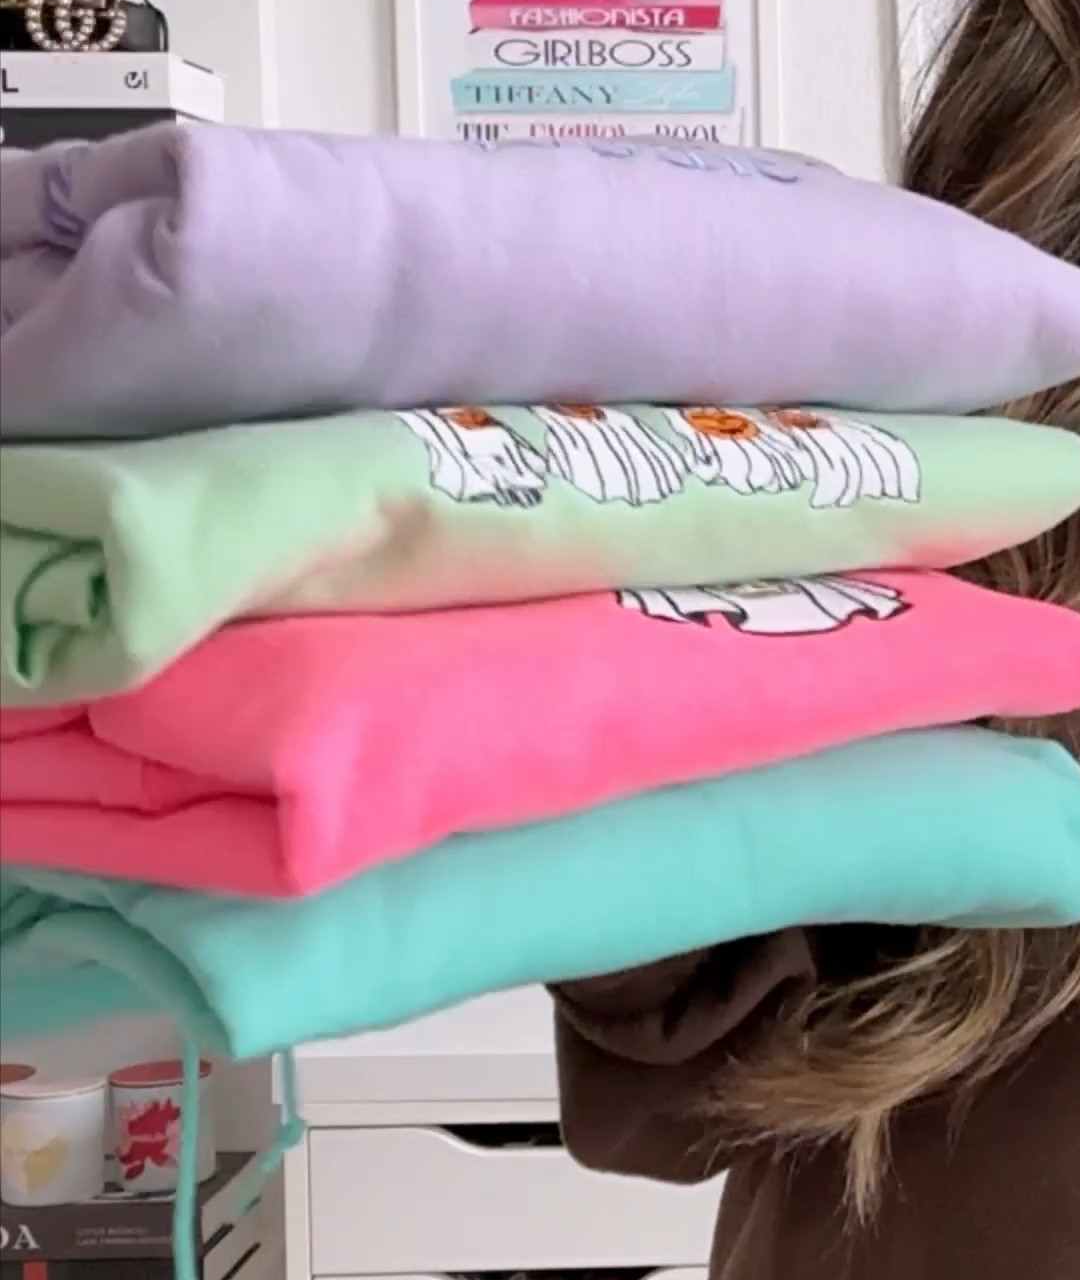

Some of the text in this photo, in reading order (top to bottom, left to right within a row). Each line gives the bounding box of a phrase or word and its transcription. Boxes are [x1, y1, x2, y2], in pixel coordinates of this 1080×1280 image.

[510, 7, 685, 26] FASHIONISTA
[493, 38, 692, 68] GIRLBOSS
[465, 85, 617, 105] TIFFANY
